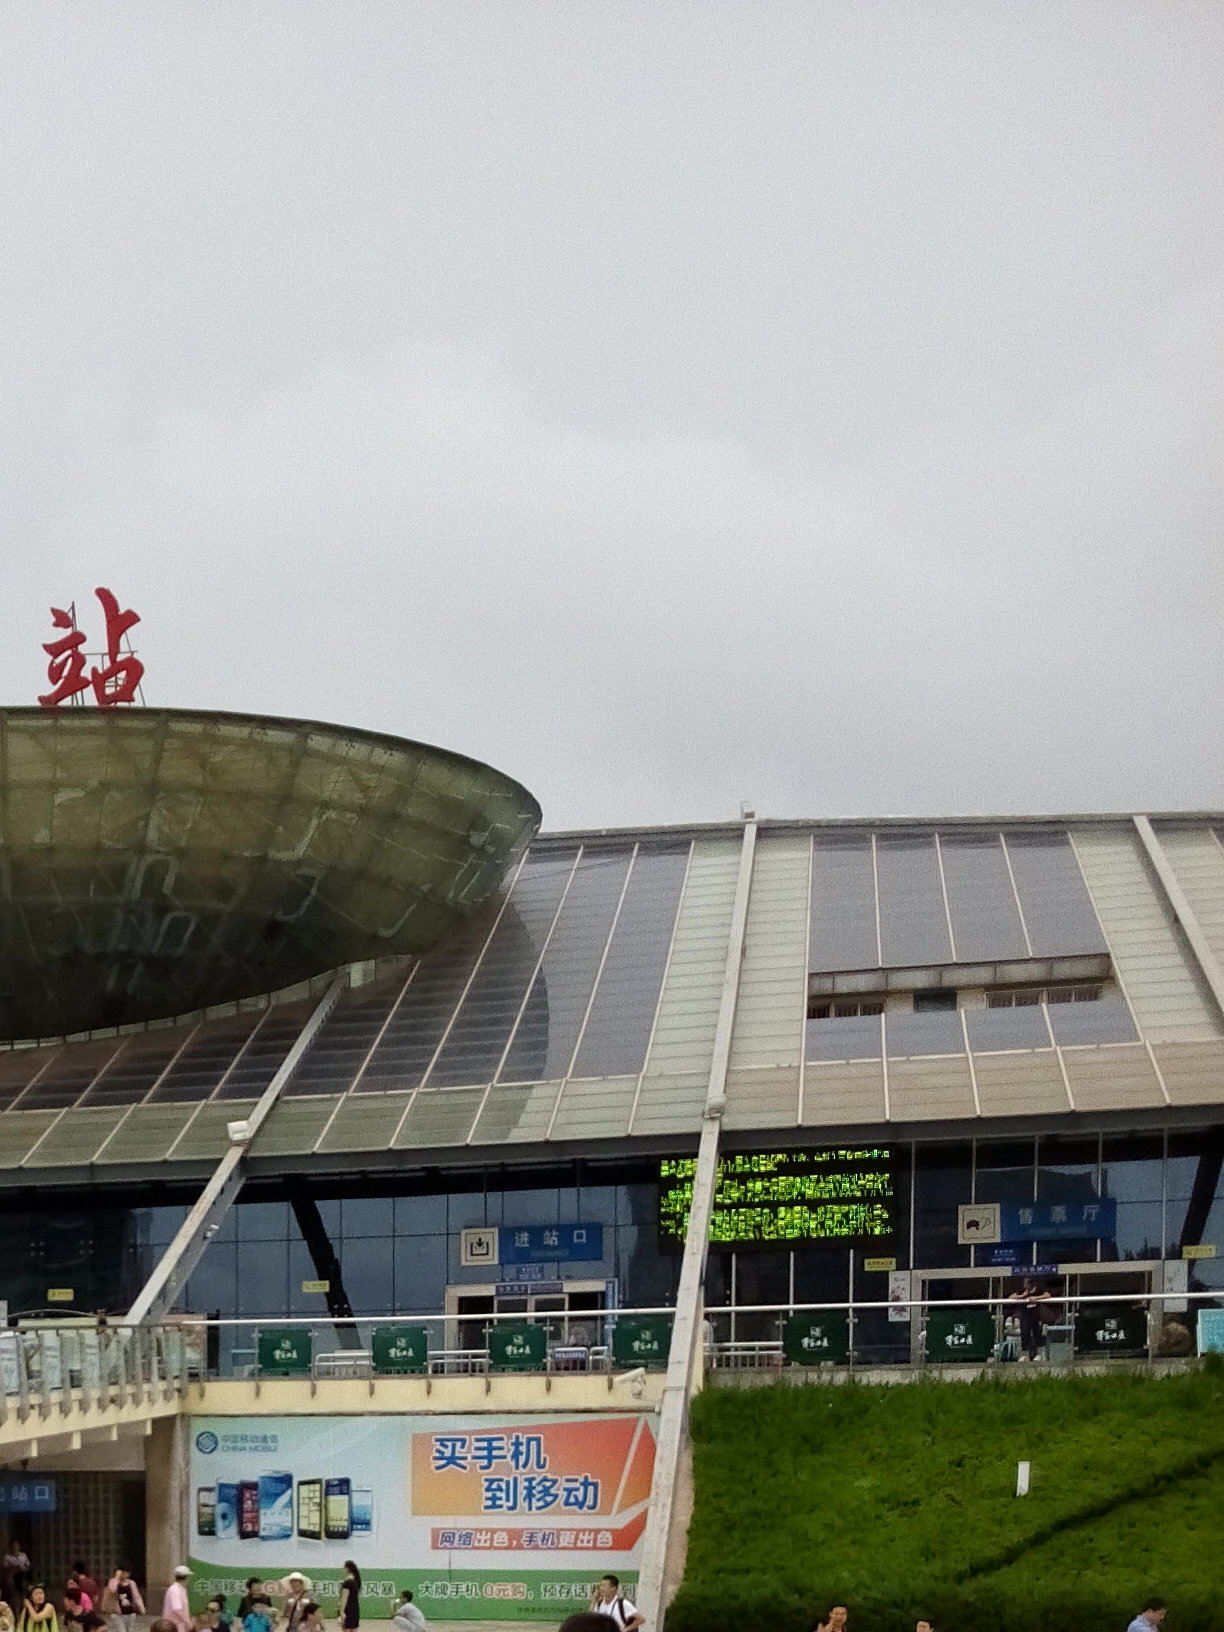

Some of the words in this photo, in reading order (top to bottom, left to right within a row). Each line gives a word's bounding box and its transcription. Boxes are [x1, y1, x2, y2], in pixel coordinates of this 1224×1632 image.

[514, 1229, 588, 1248] 进站口
[432, 1434, 548, 1472] 买手机
[482, 1475, 600, 1513] 到移动
